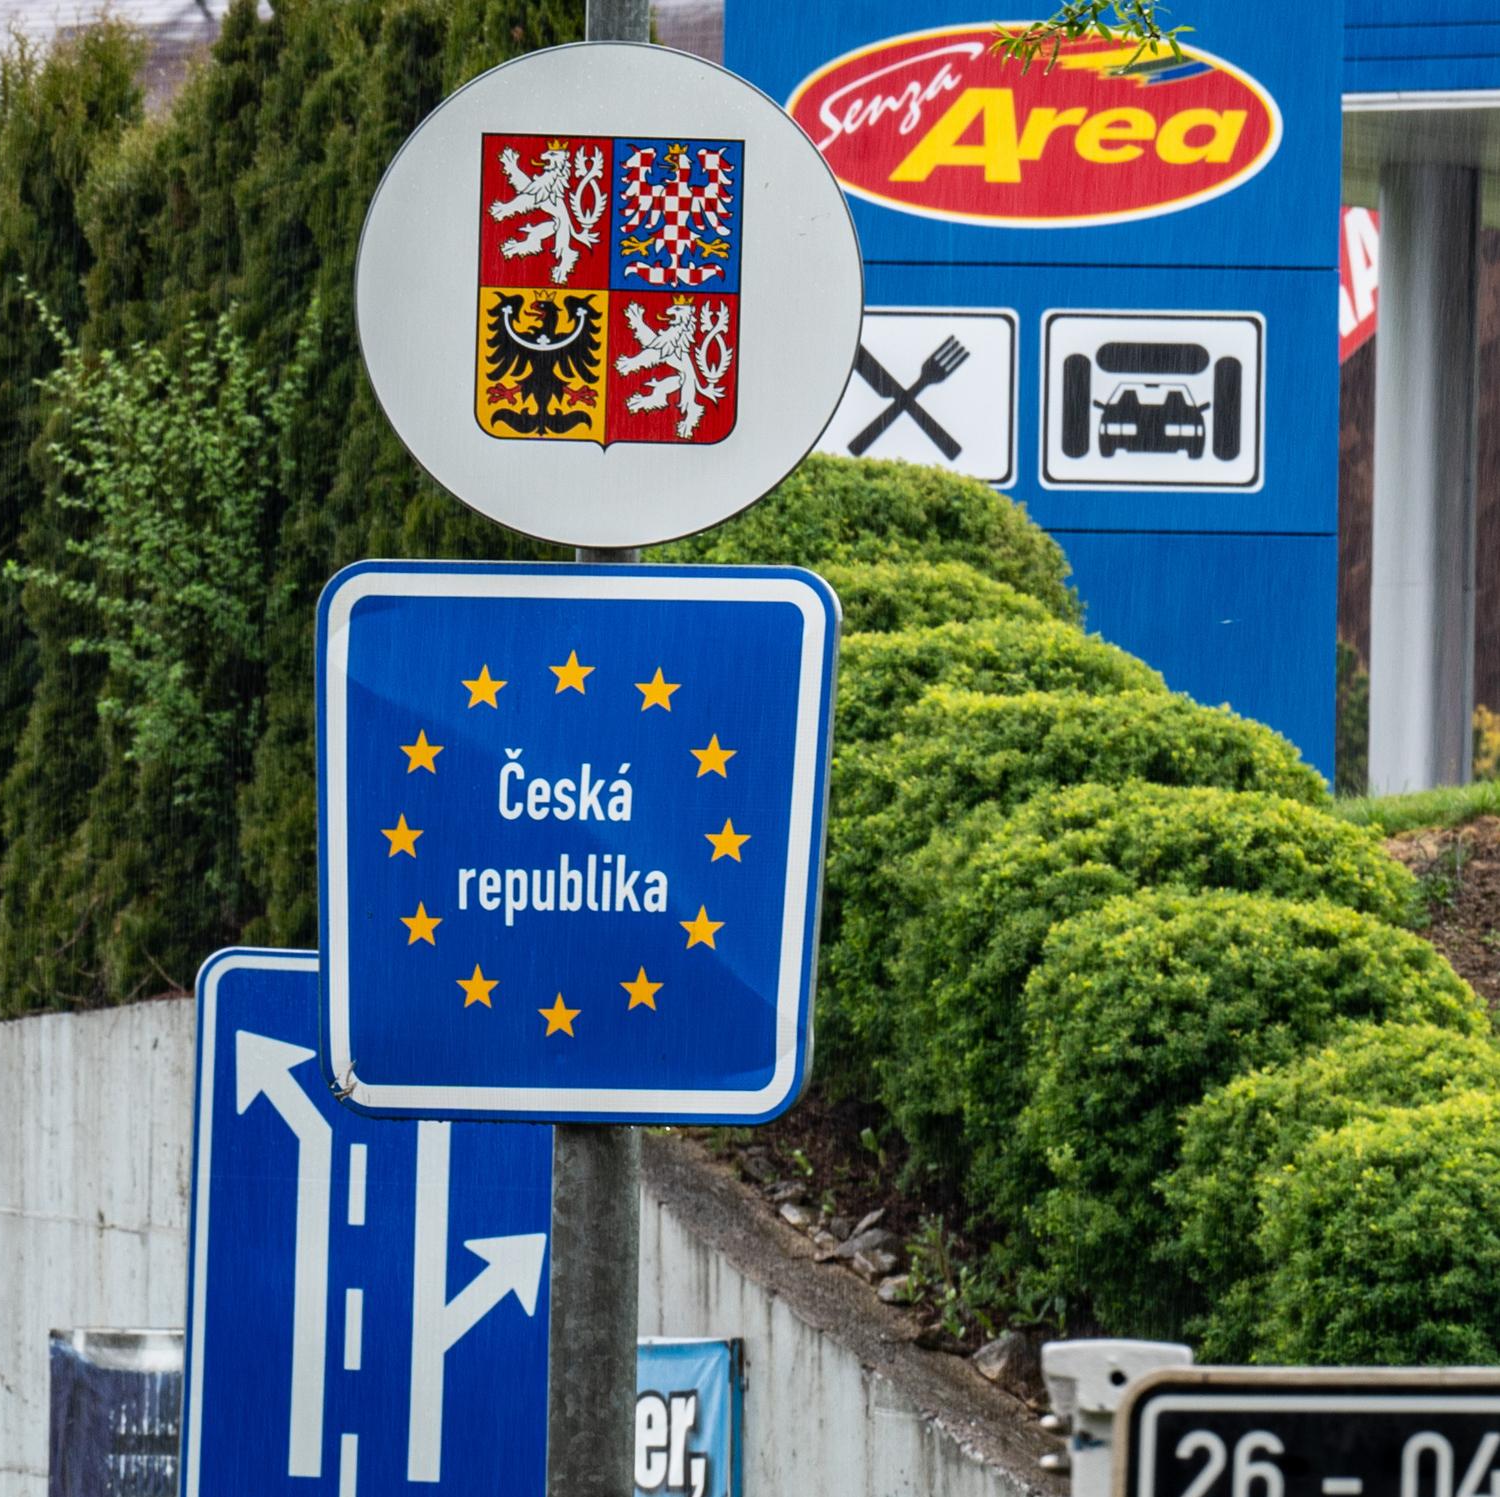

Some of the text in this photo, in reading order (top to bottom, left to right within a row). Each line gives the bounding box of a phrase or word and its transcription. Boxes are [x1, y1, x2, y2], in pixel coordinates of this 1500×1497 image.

[818, 42, 985, 149] Senza
[888, 87, 1248, 183] Area
[499, 748, 633, 822] Česká
[457, 853, 668, 927] republika
